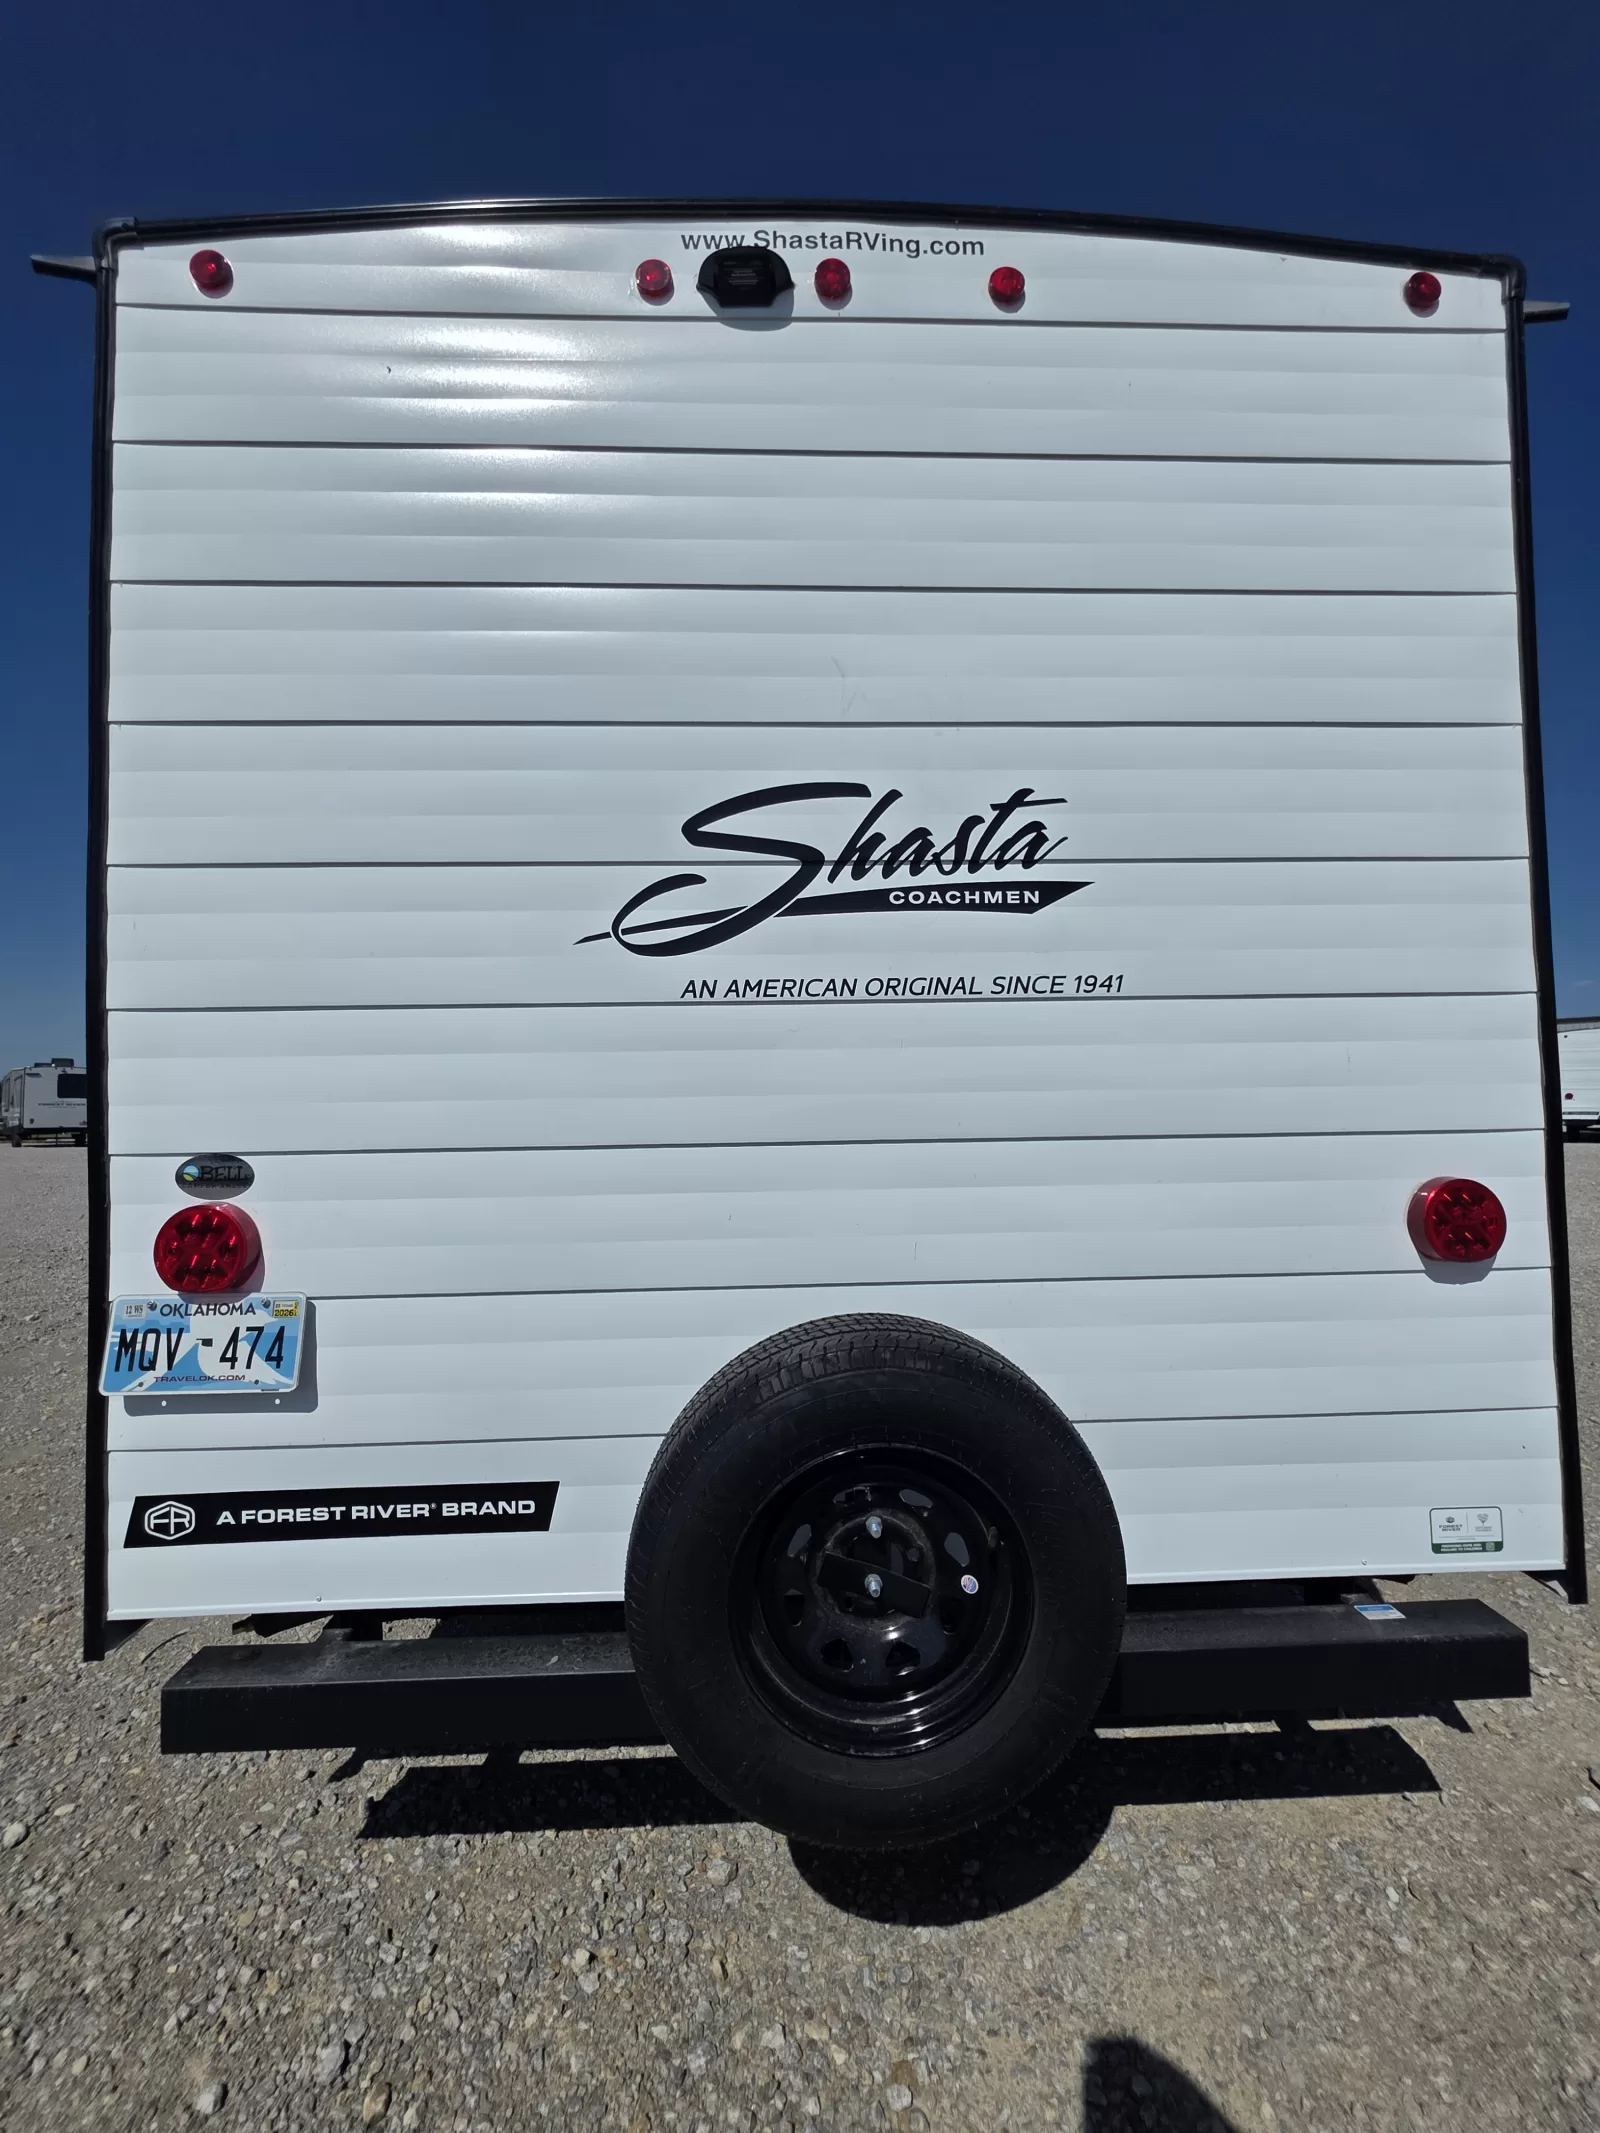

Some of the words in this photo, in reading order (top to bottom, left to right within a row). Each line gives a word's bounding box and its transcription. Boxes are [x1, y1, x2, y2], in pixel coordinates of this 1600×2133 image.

[681, 229, 985, 259] wwwShastaRVing.com
[611, 781, 1069, 957] Shasta
[889, 890, 1040, 905] COACHMEN
[680, 979, 718, 999] AN
[723, 978, 858, 999] AMERICAN
[864, 976, 984, 998] ORIGINAL
[990, 975, 1067, 996] SINCE
[1073, 974, 1125, 995] 1941
[200, 1165, 248, 1181] BELL
[159, 1302, 257, 1319] OKLAHOMA
[274, 1309, 294, 1317] 2026
[114, 1327, 185, 1373] MQV
[219, 1325, 286, 1370] 474
[153, 1374, 246, 1383] TRAVELOK.COM
[216, 1510, 237, 1525] A
[241, 1506, 347, 1525] FOREST
[442, 1500, 536, 1517] BRAND
